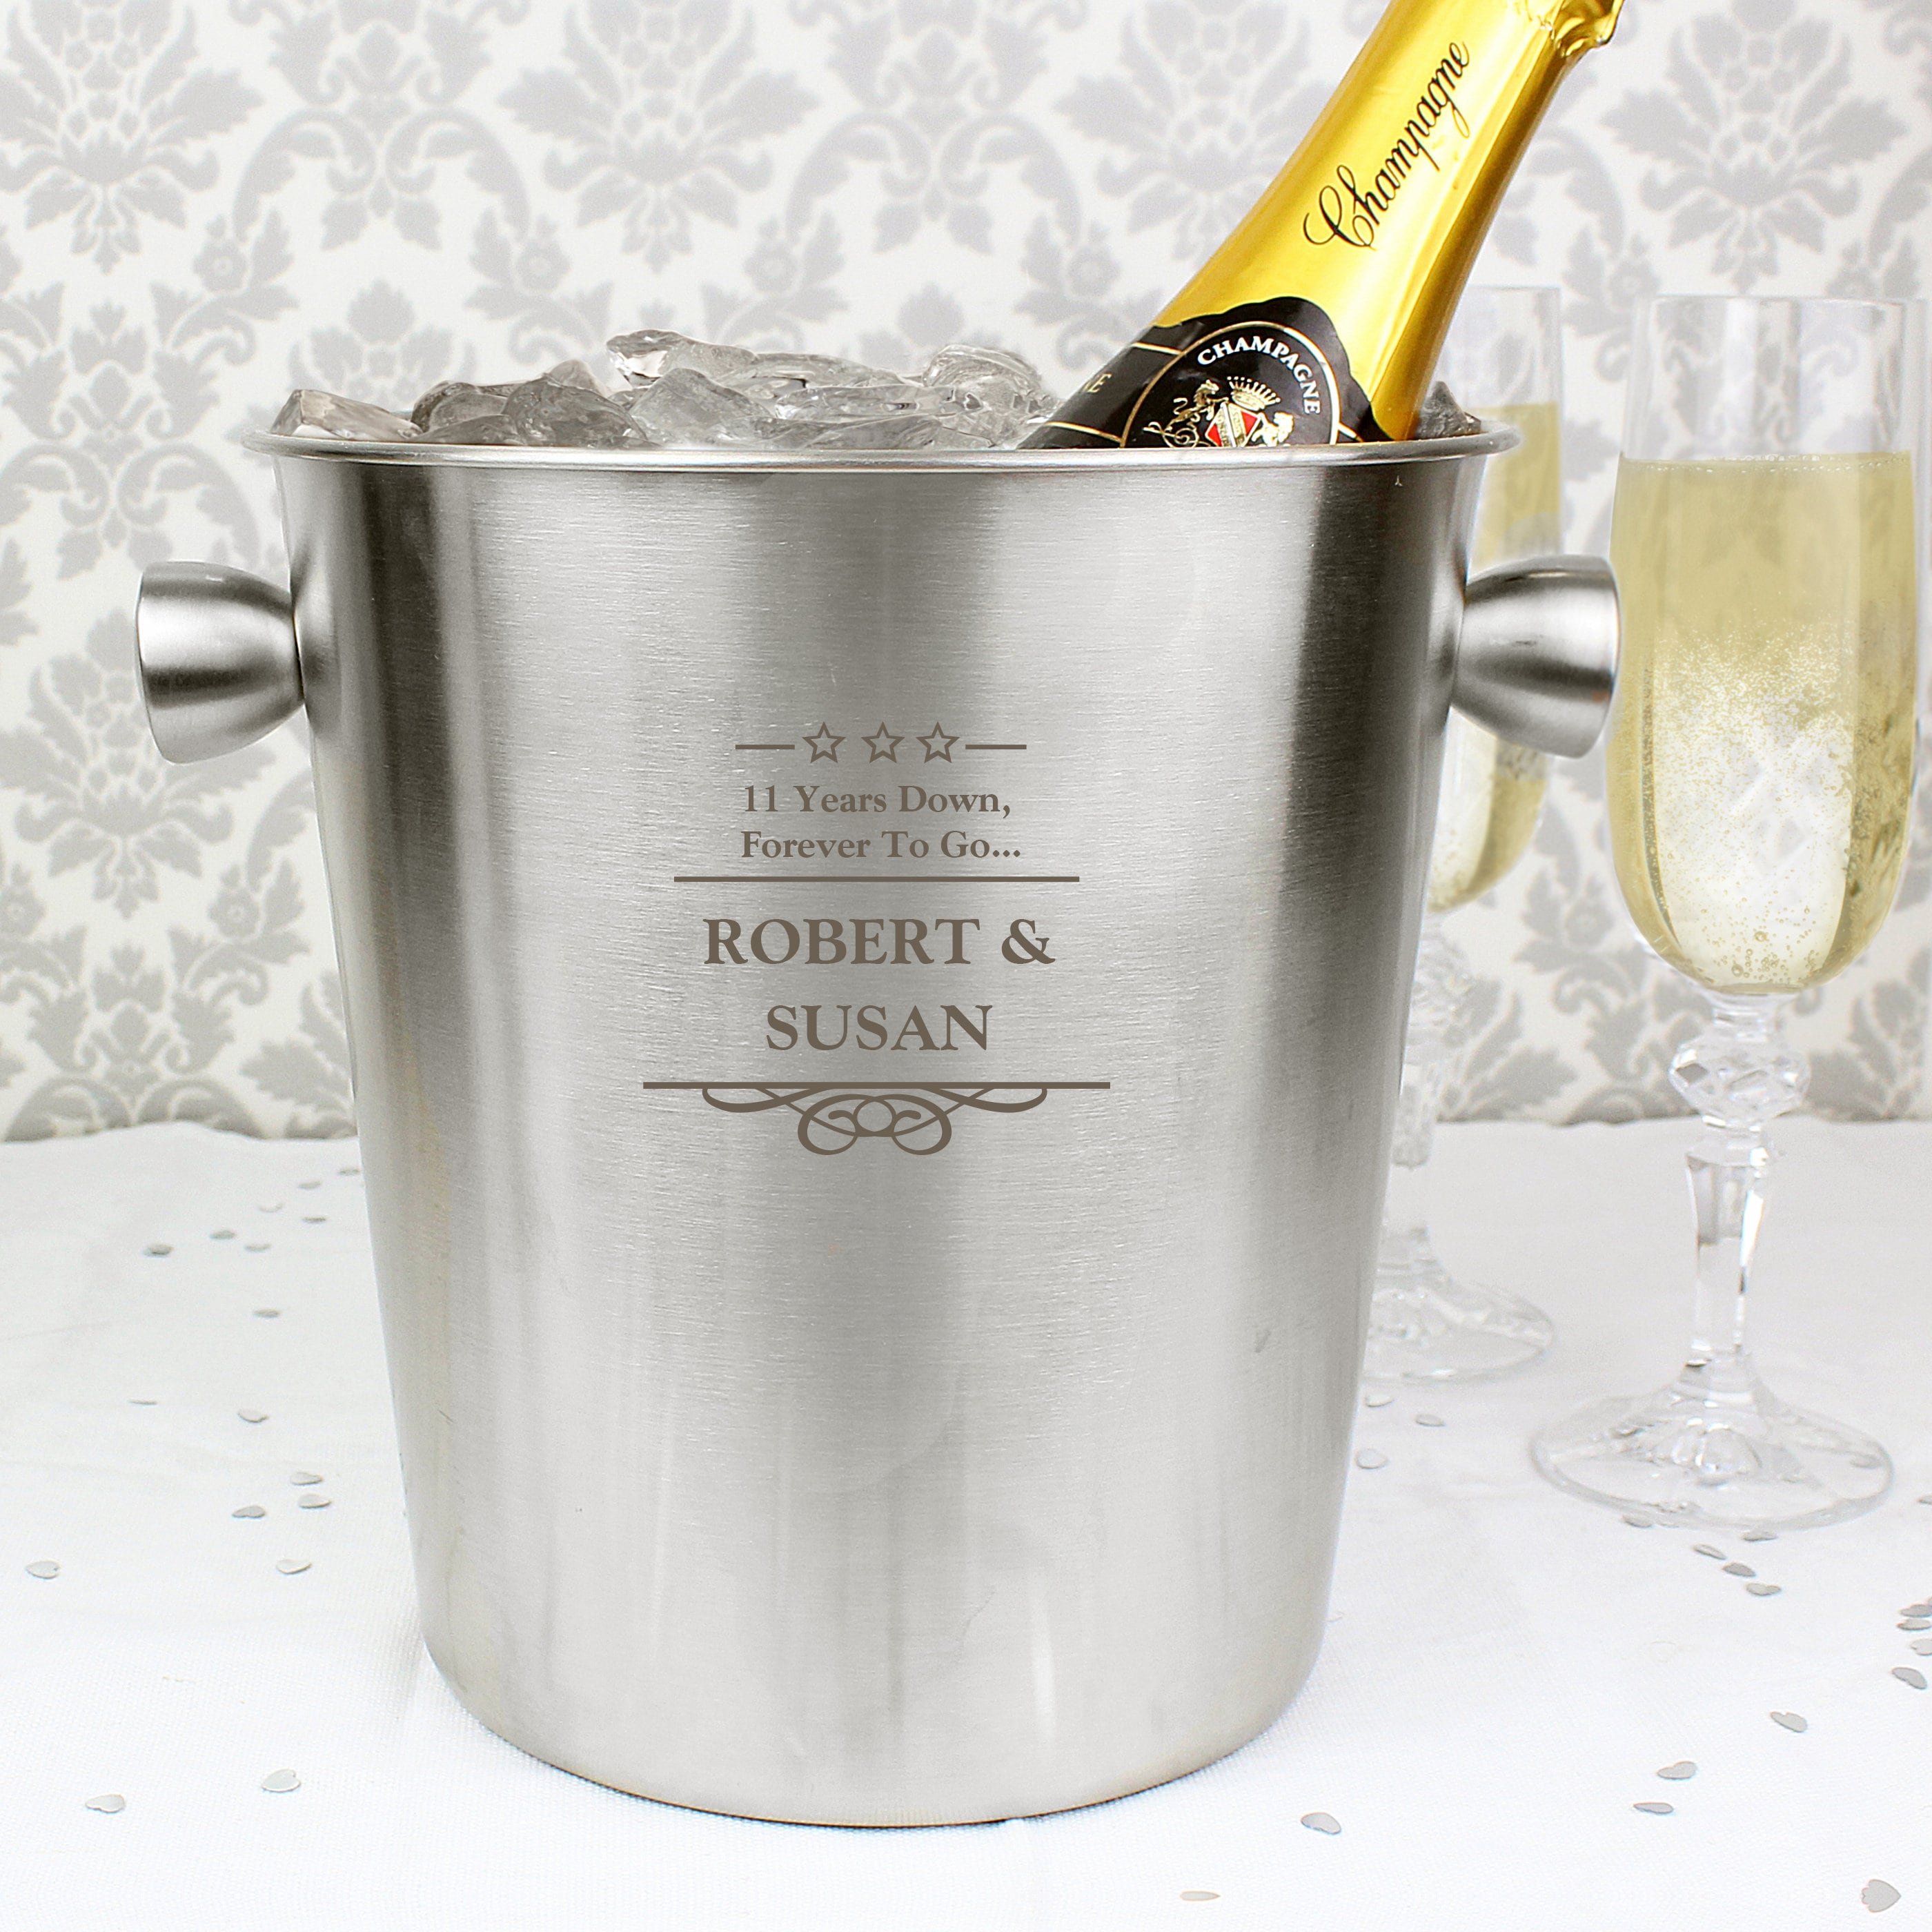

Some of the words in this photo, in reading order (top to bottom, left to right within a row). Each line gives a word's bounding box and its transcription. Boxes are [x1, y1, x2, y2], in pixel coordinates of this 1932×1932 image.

[1303, 41, 1470, 250] Champagne
[1197, 335, 1321, 414] CHAMPAGNE
[744, 785, 779, 812] 11
[793, 785, 887, 813] Years
[898, 785, 1011, 819] Down,
[741, 830, 871, 858] Forever
[880, 830, 929, 858] To
[940, 830, 1021, 858] Go...
[702, 918, 980, 965] ROBERT
[1000, 918, 1056, 965] &
[766, 1005, 994, 1051] SUSAN
